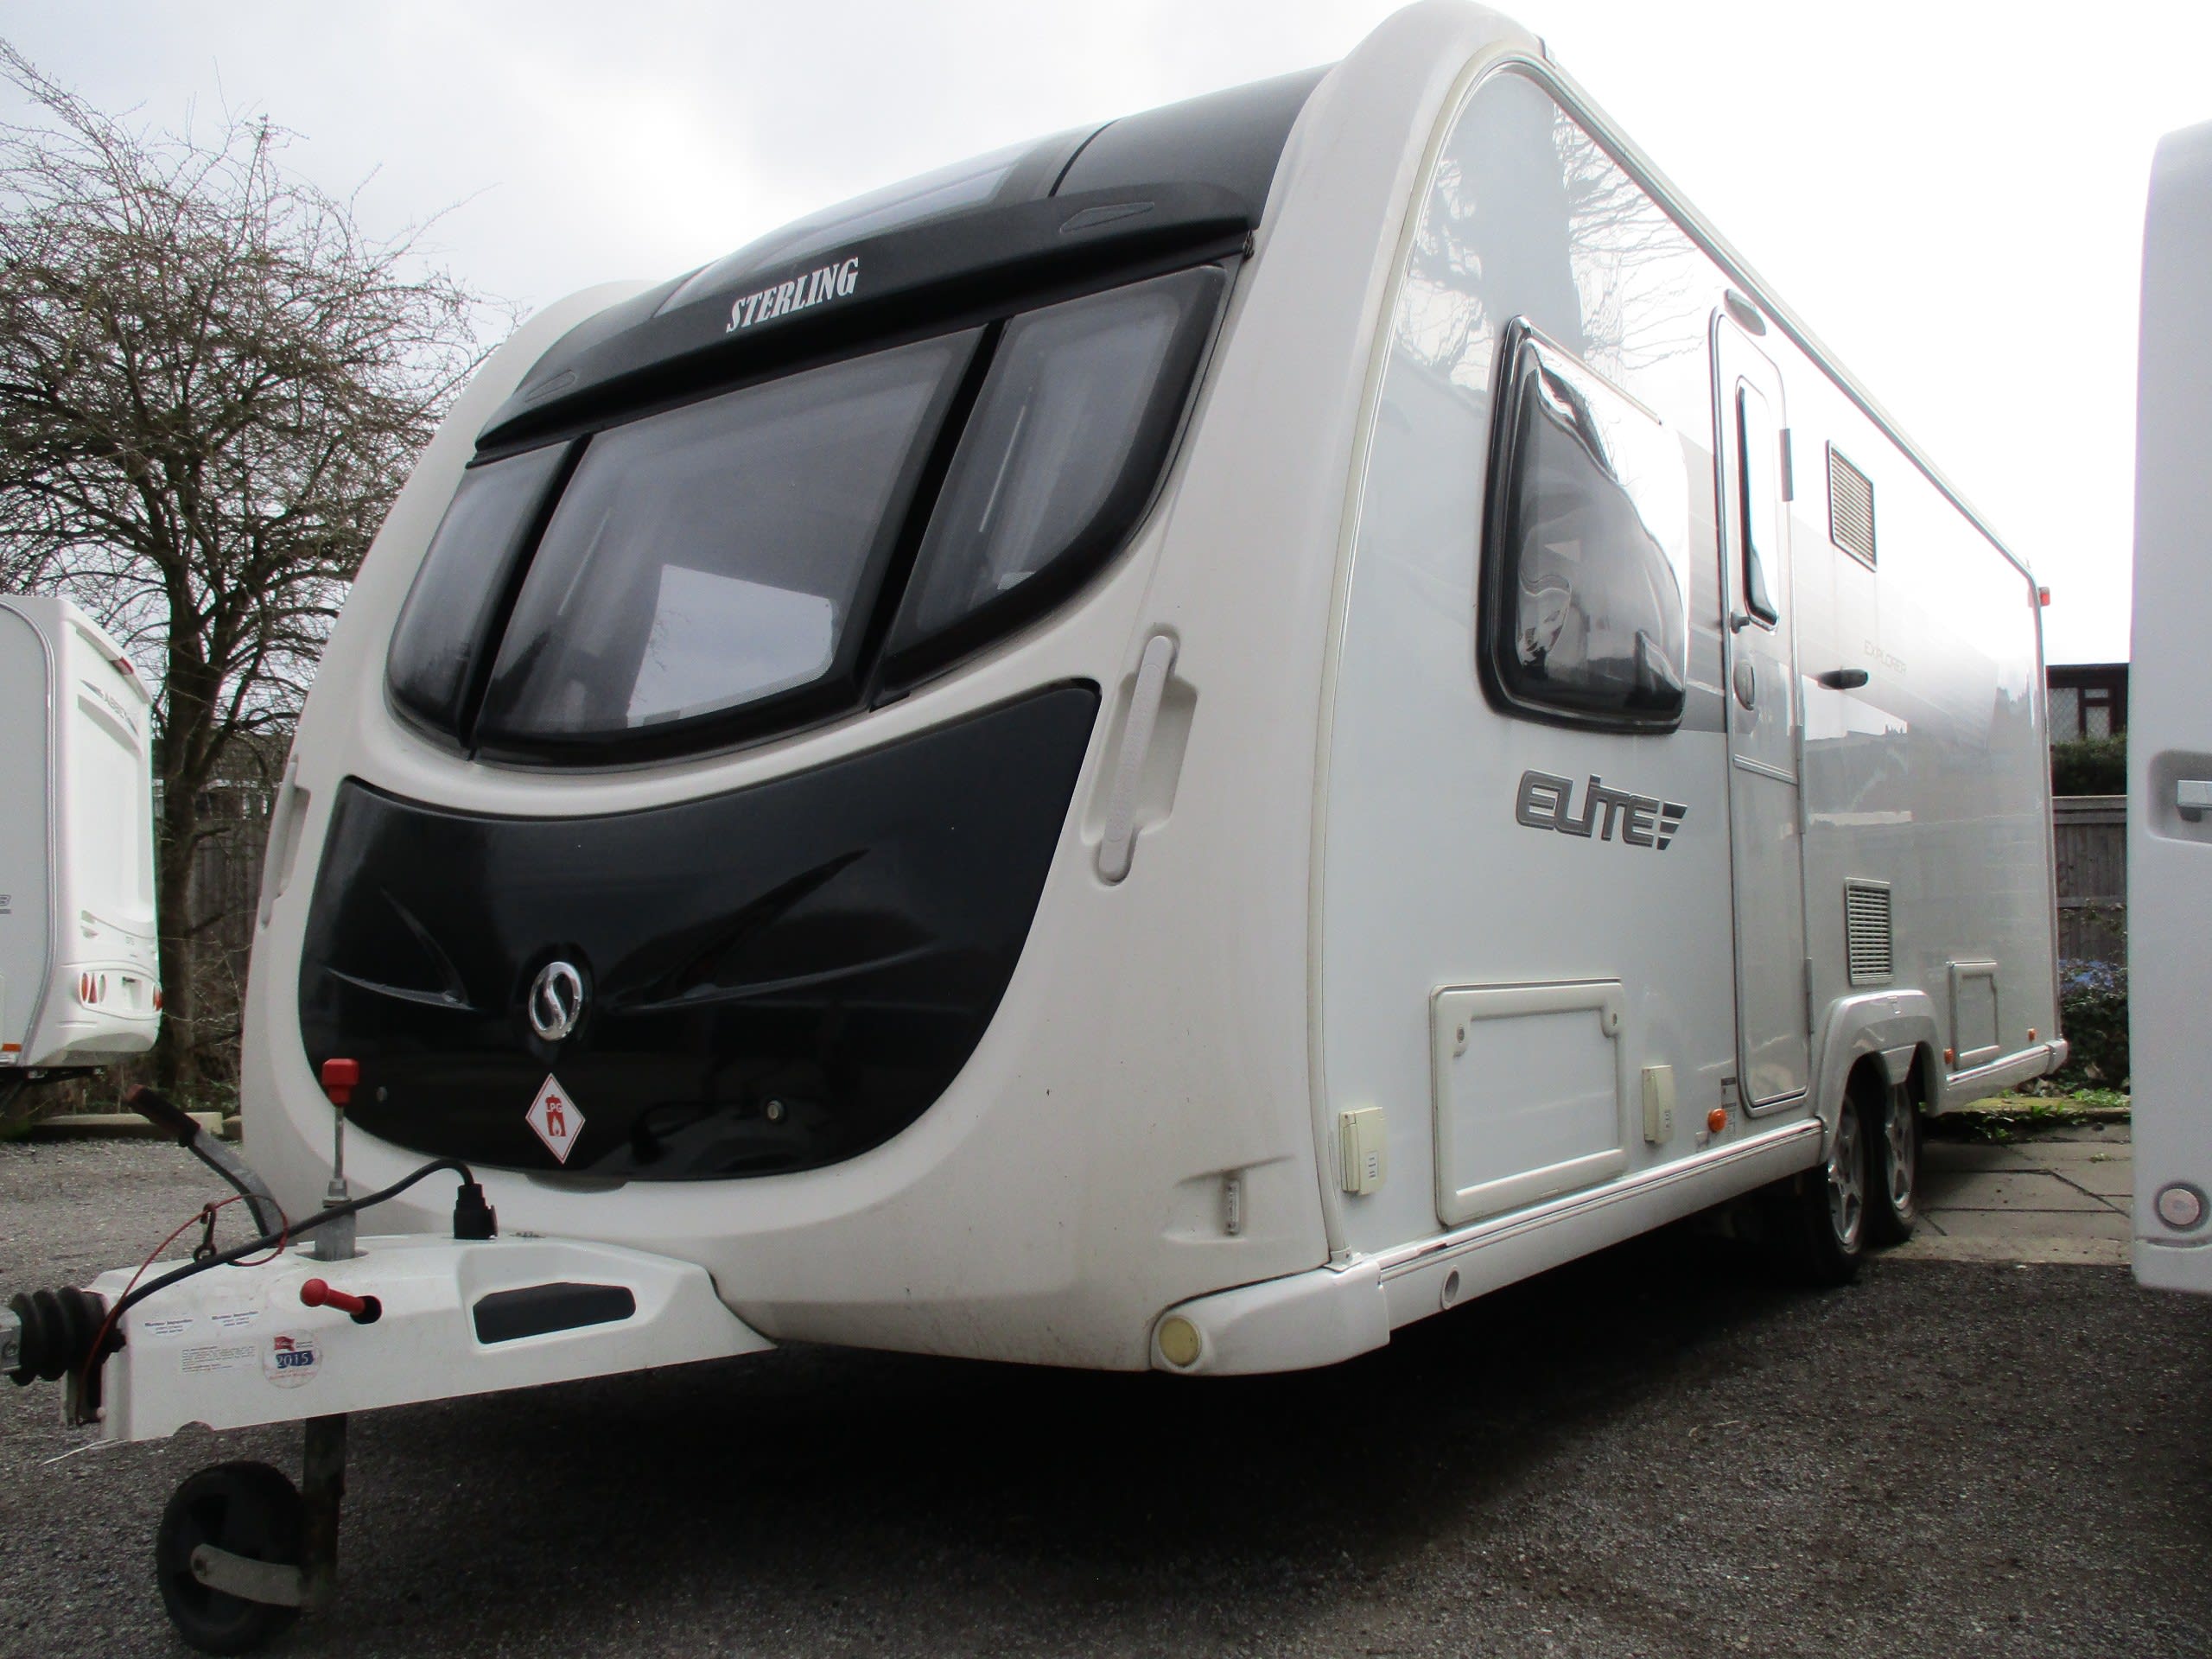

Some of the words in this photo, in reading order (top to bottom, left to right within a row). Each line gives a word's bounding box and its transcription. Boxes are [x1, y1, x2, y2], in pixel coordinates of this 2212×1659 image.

[726, 257, 858, 333] STERLING
[1516, 769, 1687, 850] ELITE
[545, 1103, 563, 1113] LPG
[277, 1352, 309, 1368] 2015
